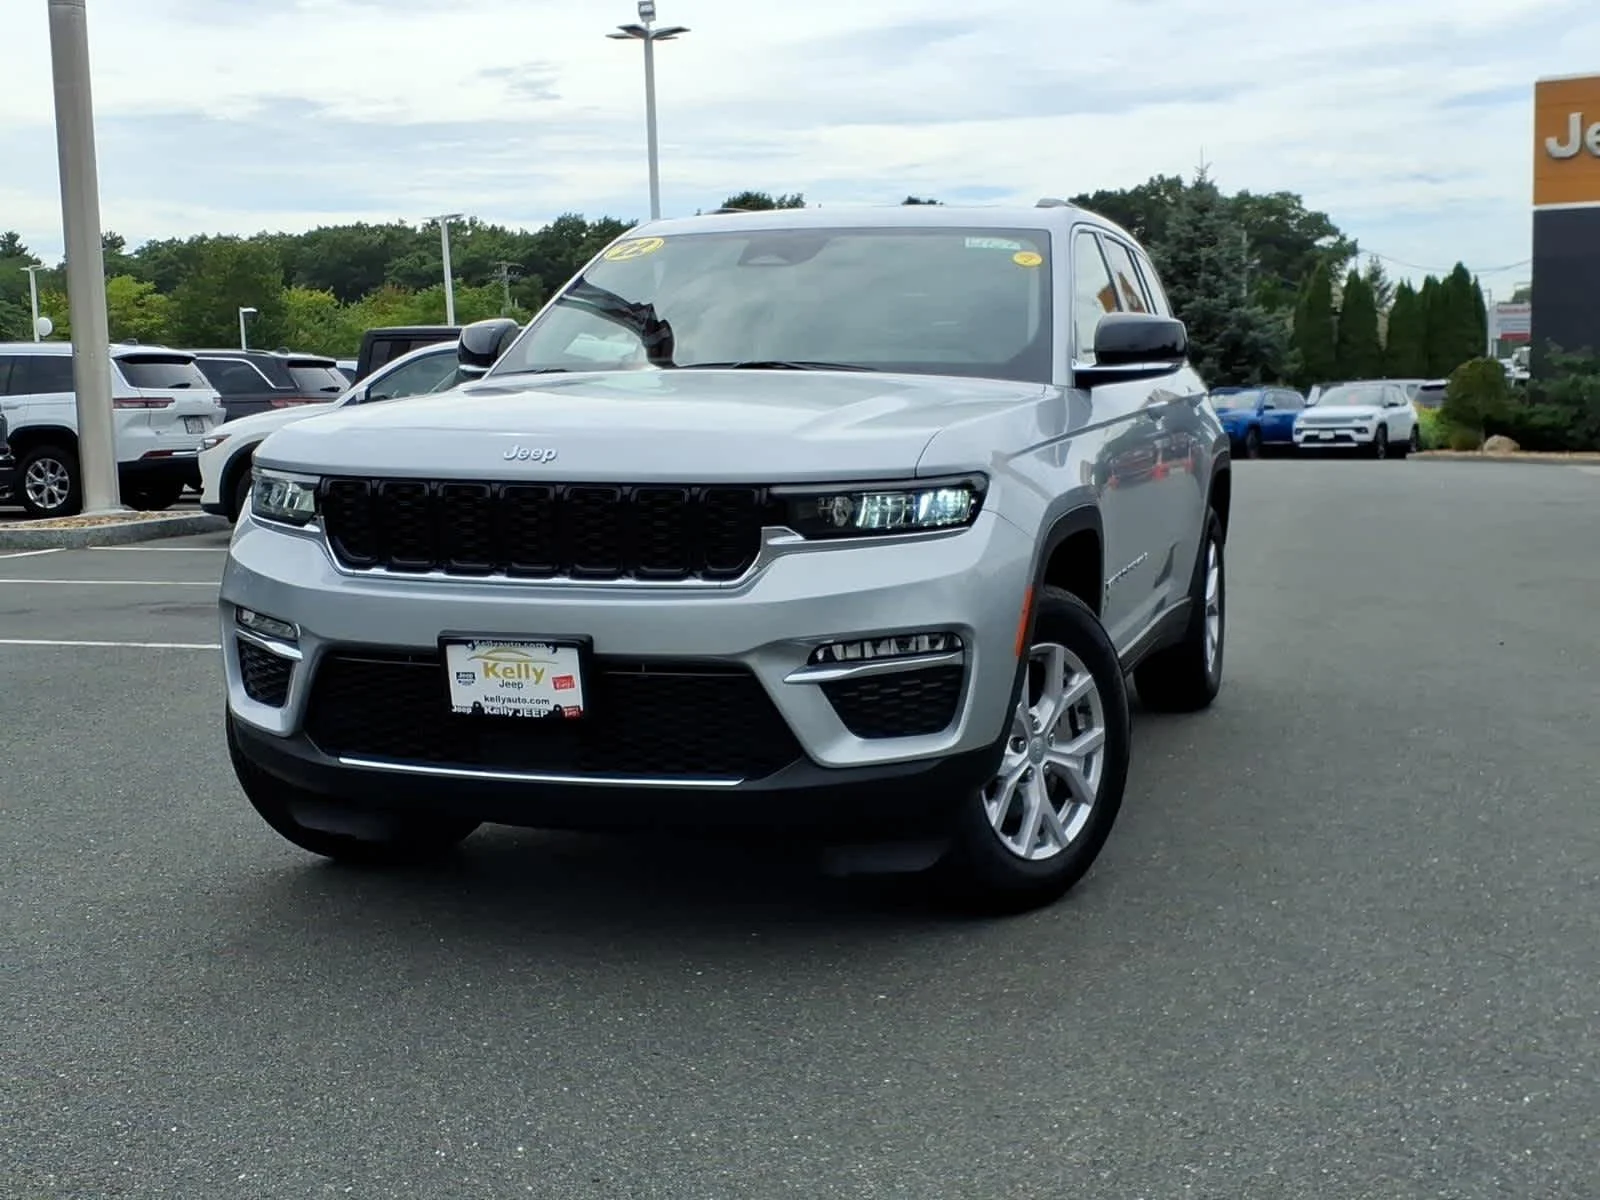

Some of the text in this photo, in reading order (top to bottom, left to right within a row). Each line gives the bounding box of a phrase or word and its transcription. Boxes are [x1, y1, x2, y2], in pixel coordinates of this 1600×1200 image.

[503, 444, 557, 464] Jeep
[483, 661, 545, 685] Kelly
[499, 679, 524, 691] Jeep
[484, 695, 550, 705] kellyauto.com
[516, 709, 549, 718] JEEP
